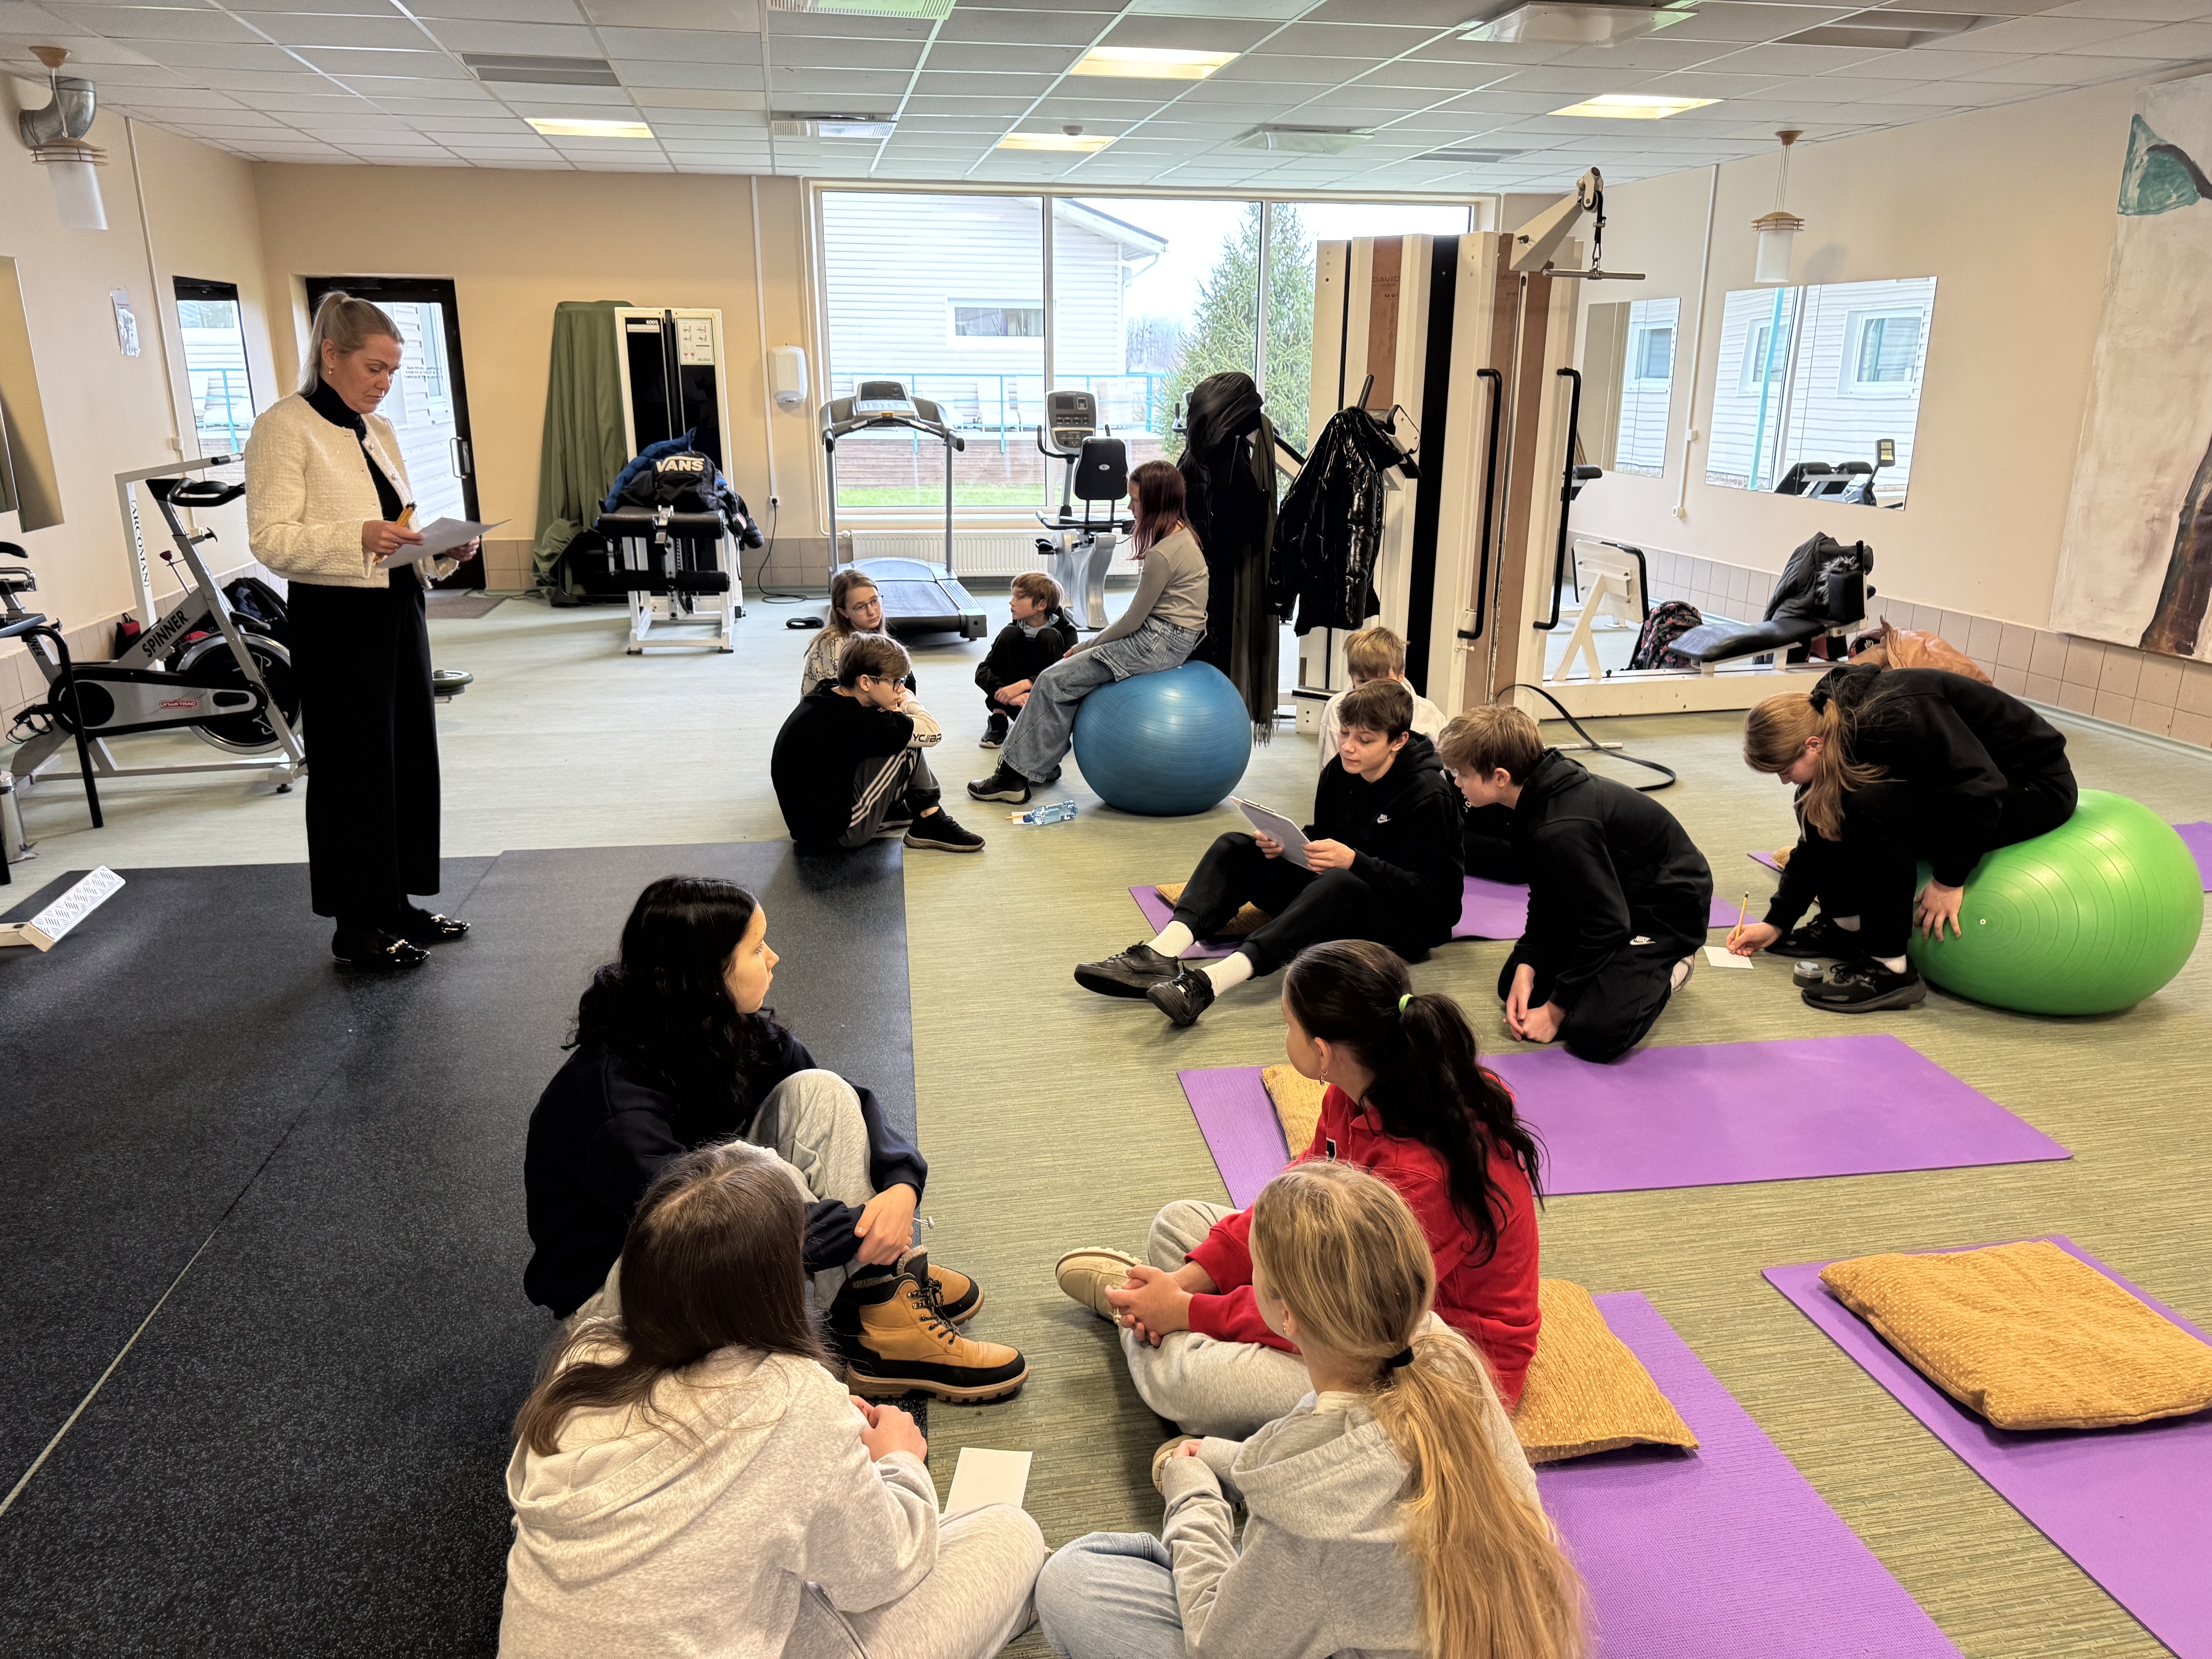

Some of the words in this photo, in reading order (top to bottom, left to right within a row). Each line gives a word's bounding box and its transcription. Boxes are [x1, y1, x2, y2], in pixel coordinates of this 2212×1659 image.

[656, 456, 704, 473] VANS
[131, 505, 150, 582] ARCOMAN
[142, 610, 188, 658] SPINNER
